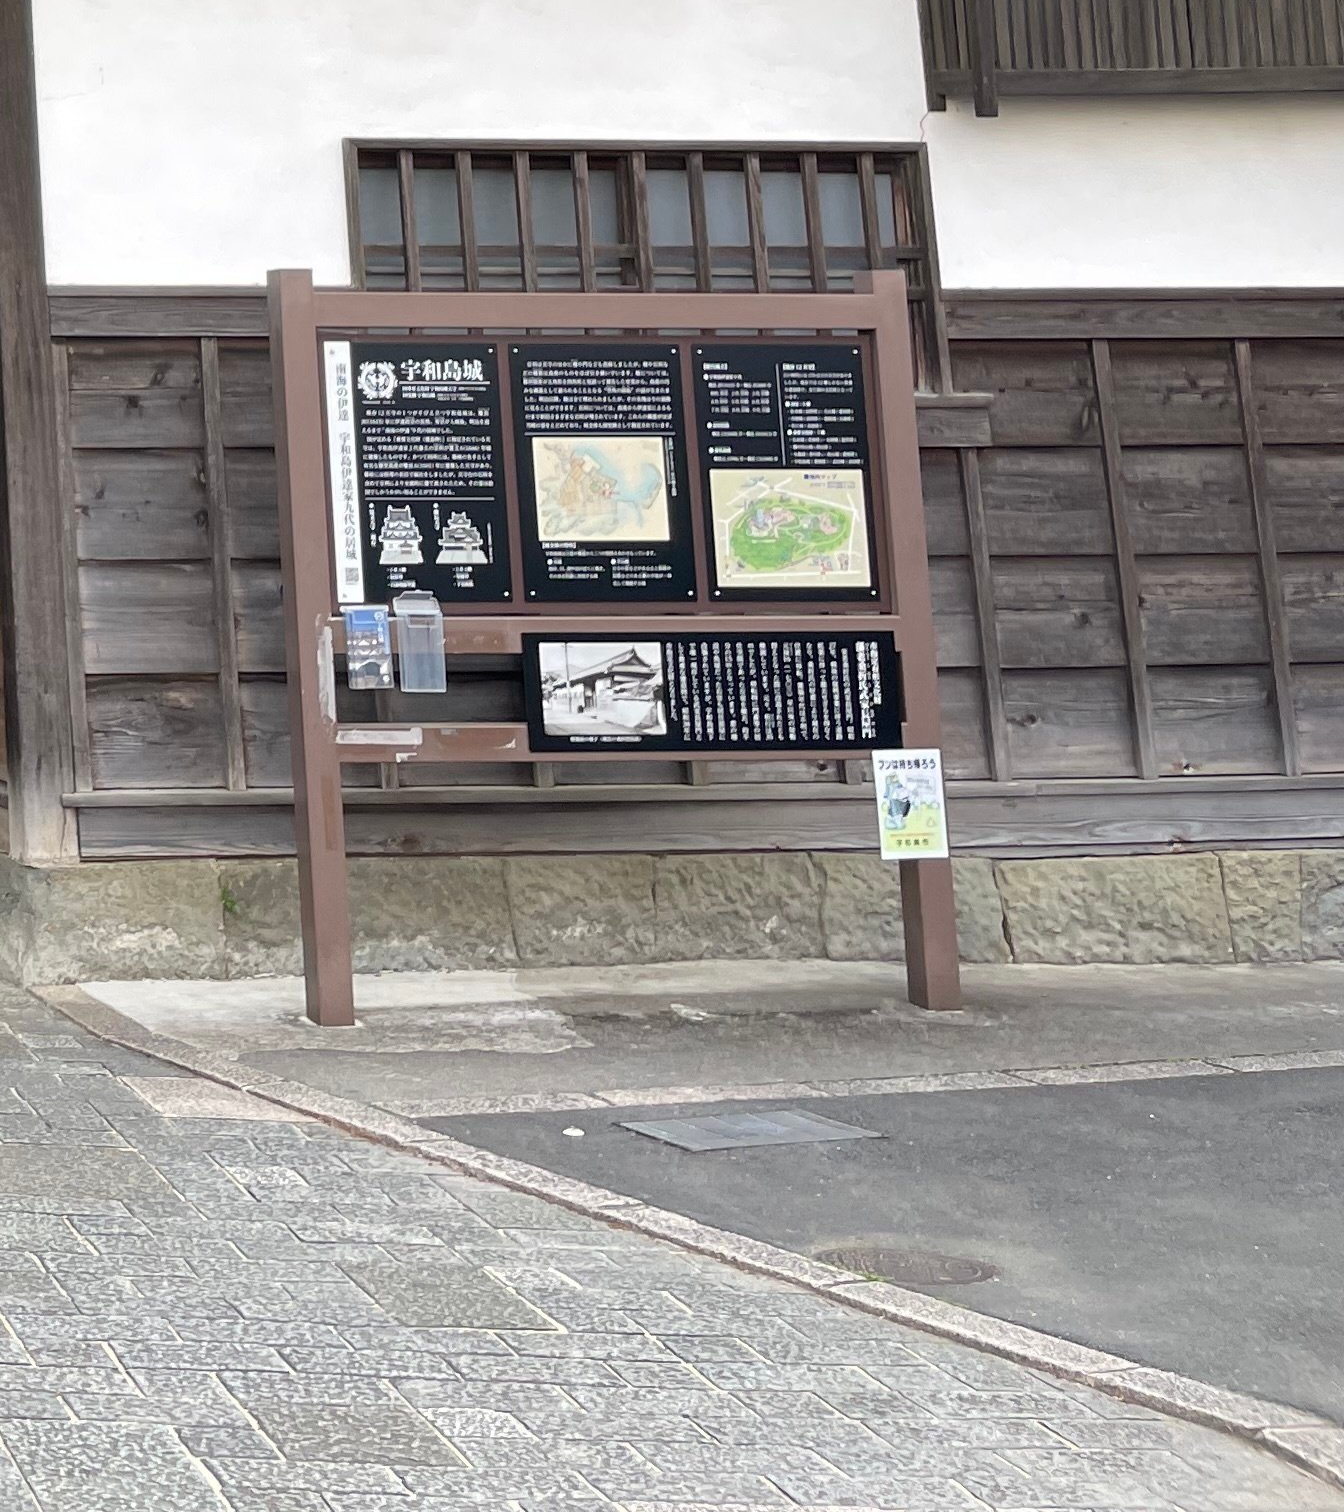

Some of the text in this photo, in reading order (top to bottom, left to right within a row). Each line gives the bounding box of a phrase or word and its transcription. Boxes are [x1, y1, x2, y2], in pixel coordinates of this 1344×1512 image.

[400, 359, 483, 381] 宇和島城
[335, 363, 349, 421] 南海の伊達
[877, 758, 937, 770] フンは持ち帰ろう
